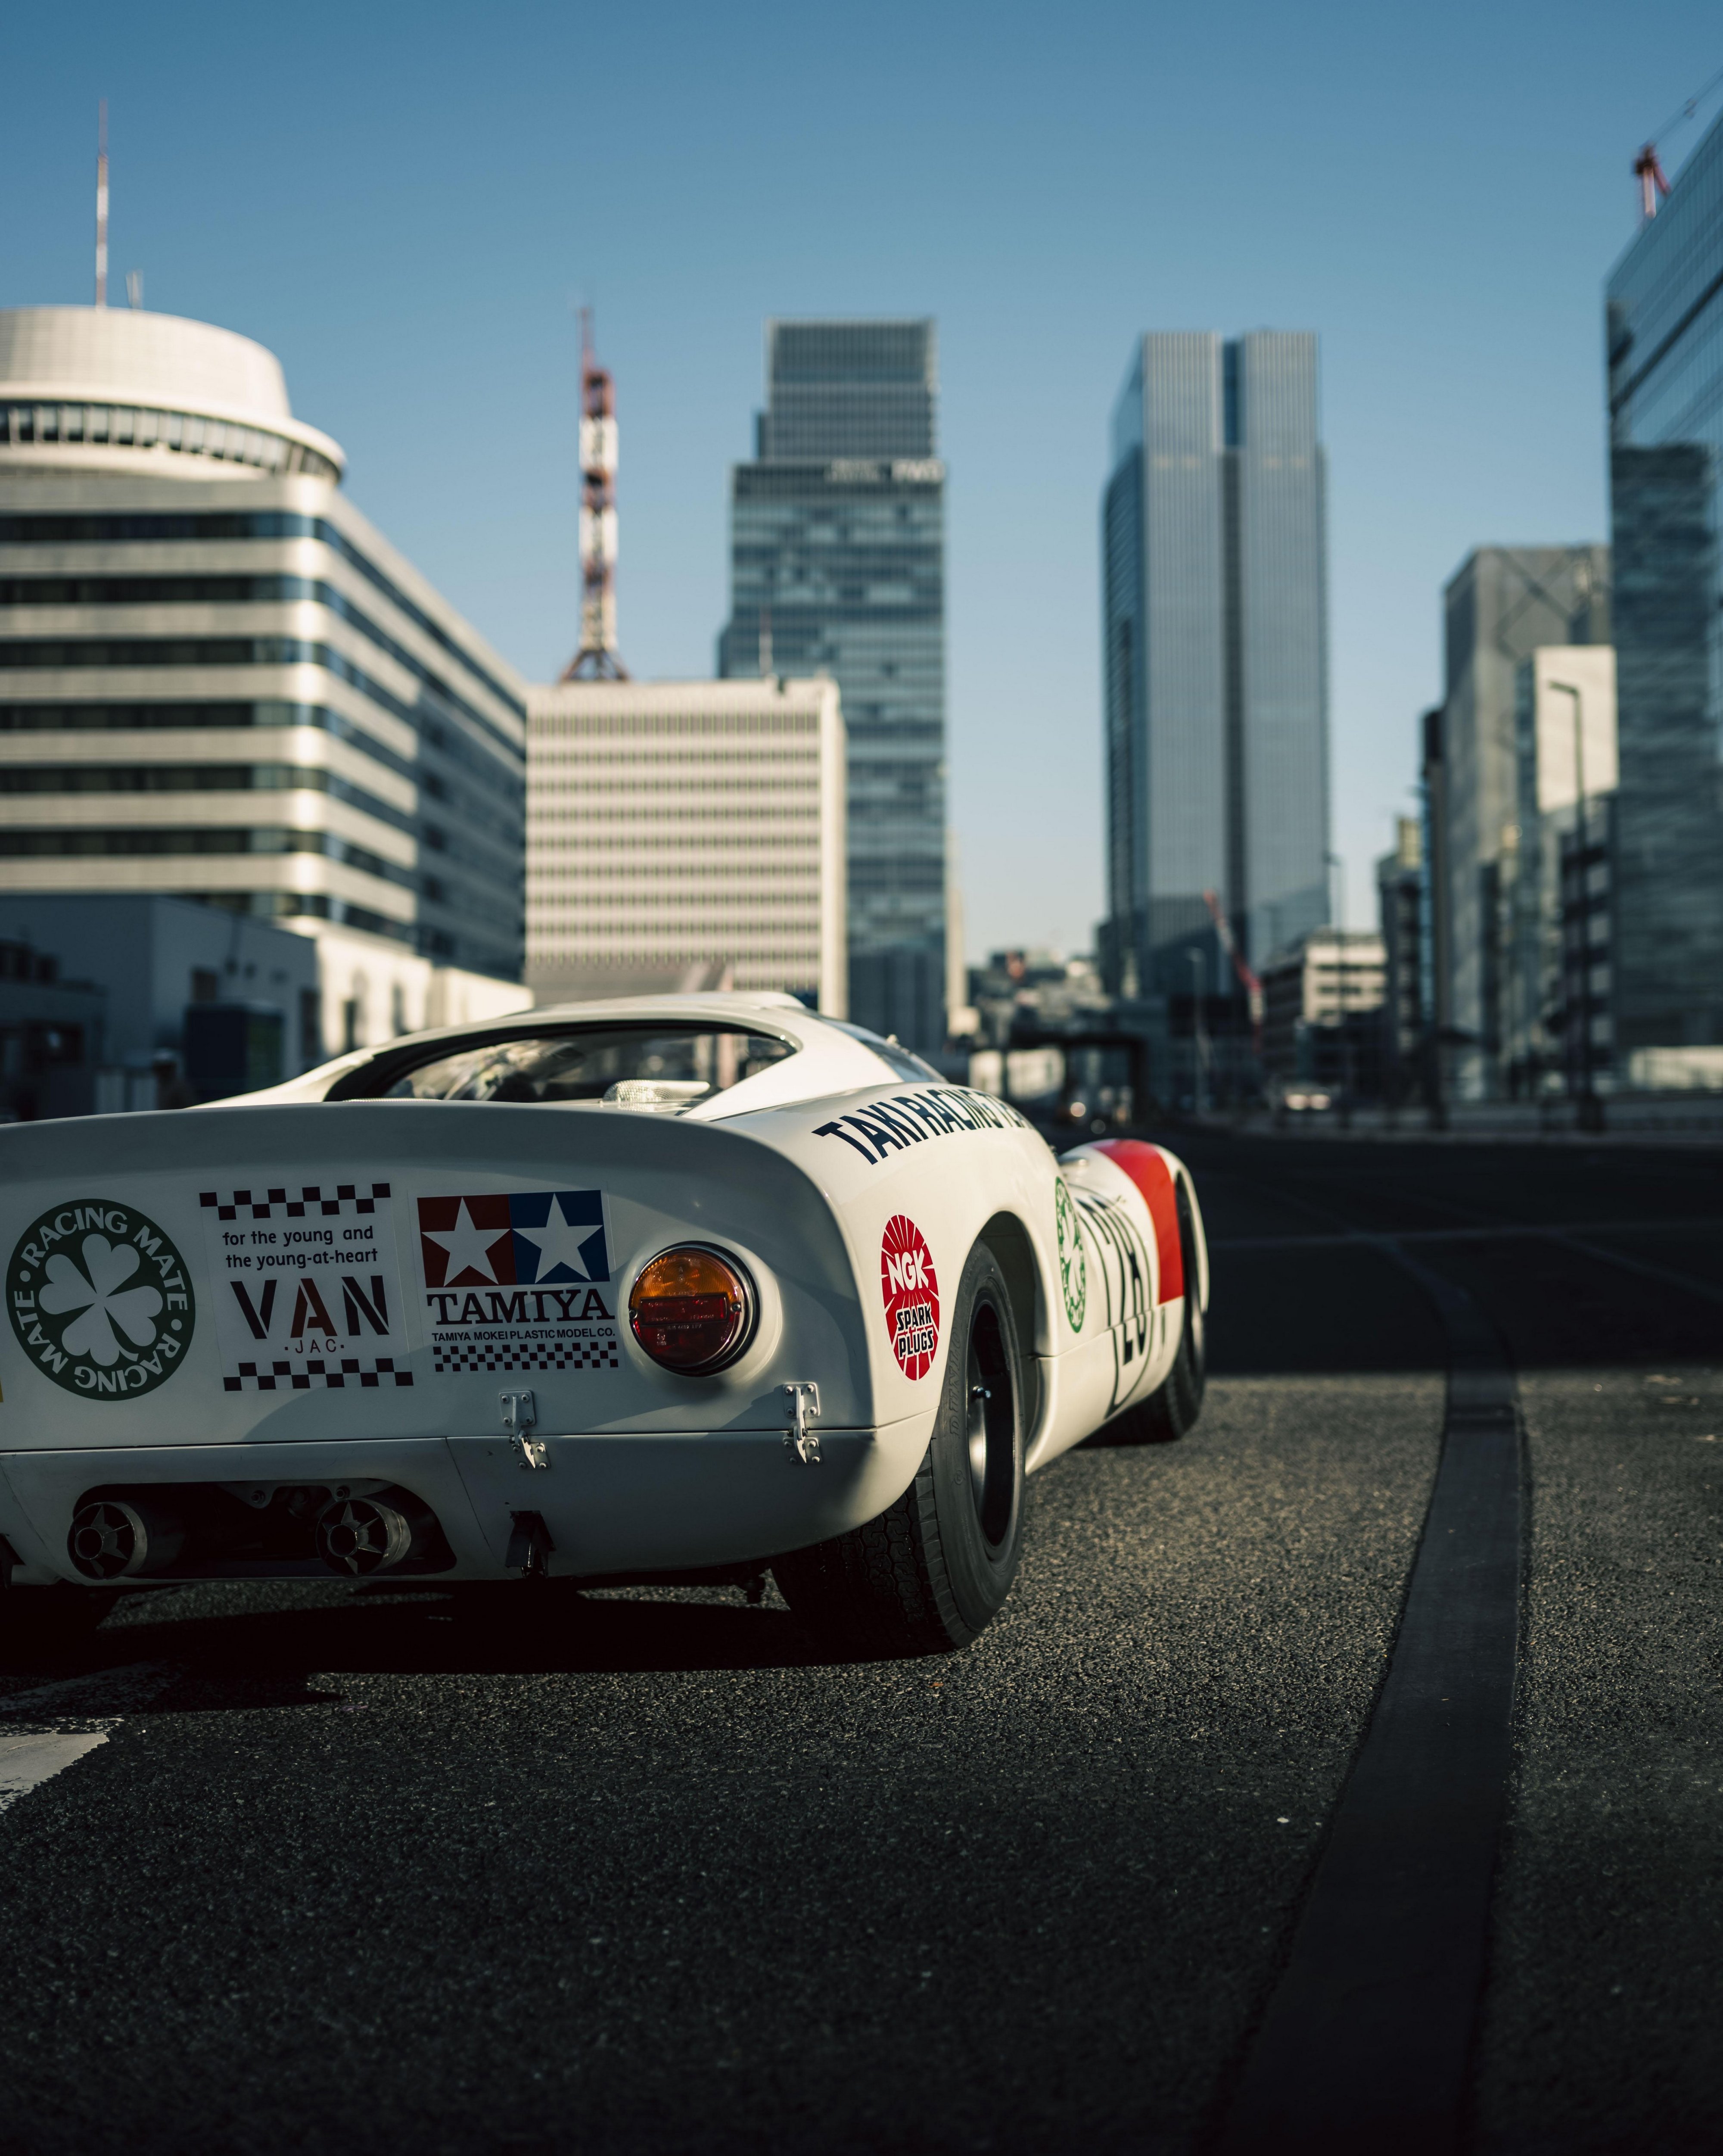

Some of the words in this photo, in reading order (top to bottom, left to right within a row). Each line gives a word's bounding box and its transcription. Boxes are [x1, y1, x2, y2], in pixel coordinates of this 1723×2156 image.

[811, 1101, 929, 1165] TAKI
[890, 1089, 1004, 1136] RACING
[21, 1207, 128, 1268] RACING
[133, 1225, 188, 1310] MATE
[222, 1232, 245, 1246] for
[251, 1231, 277, 1244] the
[283, 1229, 333, 1247] young
[343, 1225, 373, 1240] and
[226, 1254, 251, 1268] the
[257, 1248, 378, 1271] young-at-heart
[886, 1247, 929, 1295] NGK
[230, 1275, 390, 1340] VAN
[426, 1288, 616, 1325] TAMIYA
[897, 1303, 932, 1332] SPARK
[14, 1290, 68, 1374] MATE
[432, 1332, 471, 1342] TAMIYA
[474, 1330, 508, 1340] MOKEI
[510, 1329, 555, 1340] PLASTIC
[557, 1328, 596, 1338] MODEL
[597, 1327, 616, 1337] CO.
[899, 1329, 933, 1358] PLUGS
[74, 1333, 181, 1392] RACING
[949, 1310, 962, 1439] DUNLO
